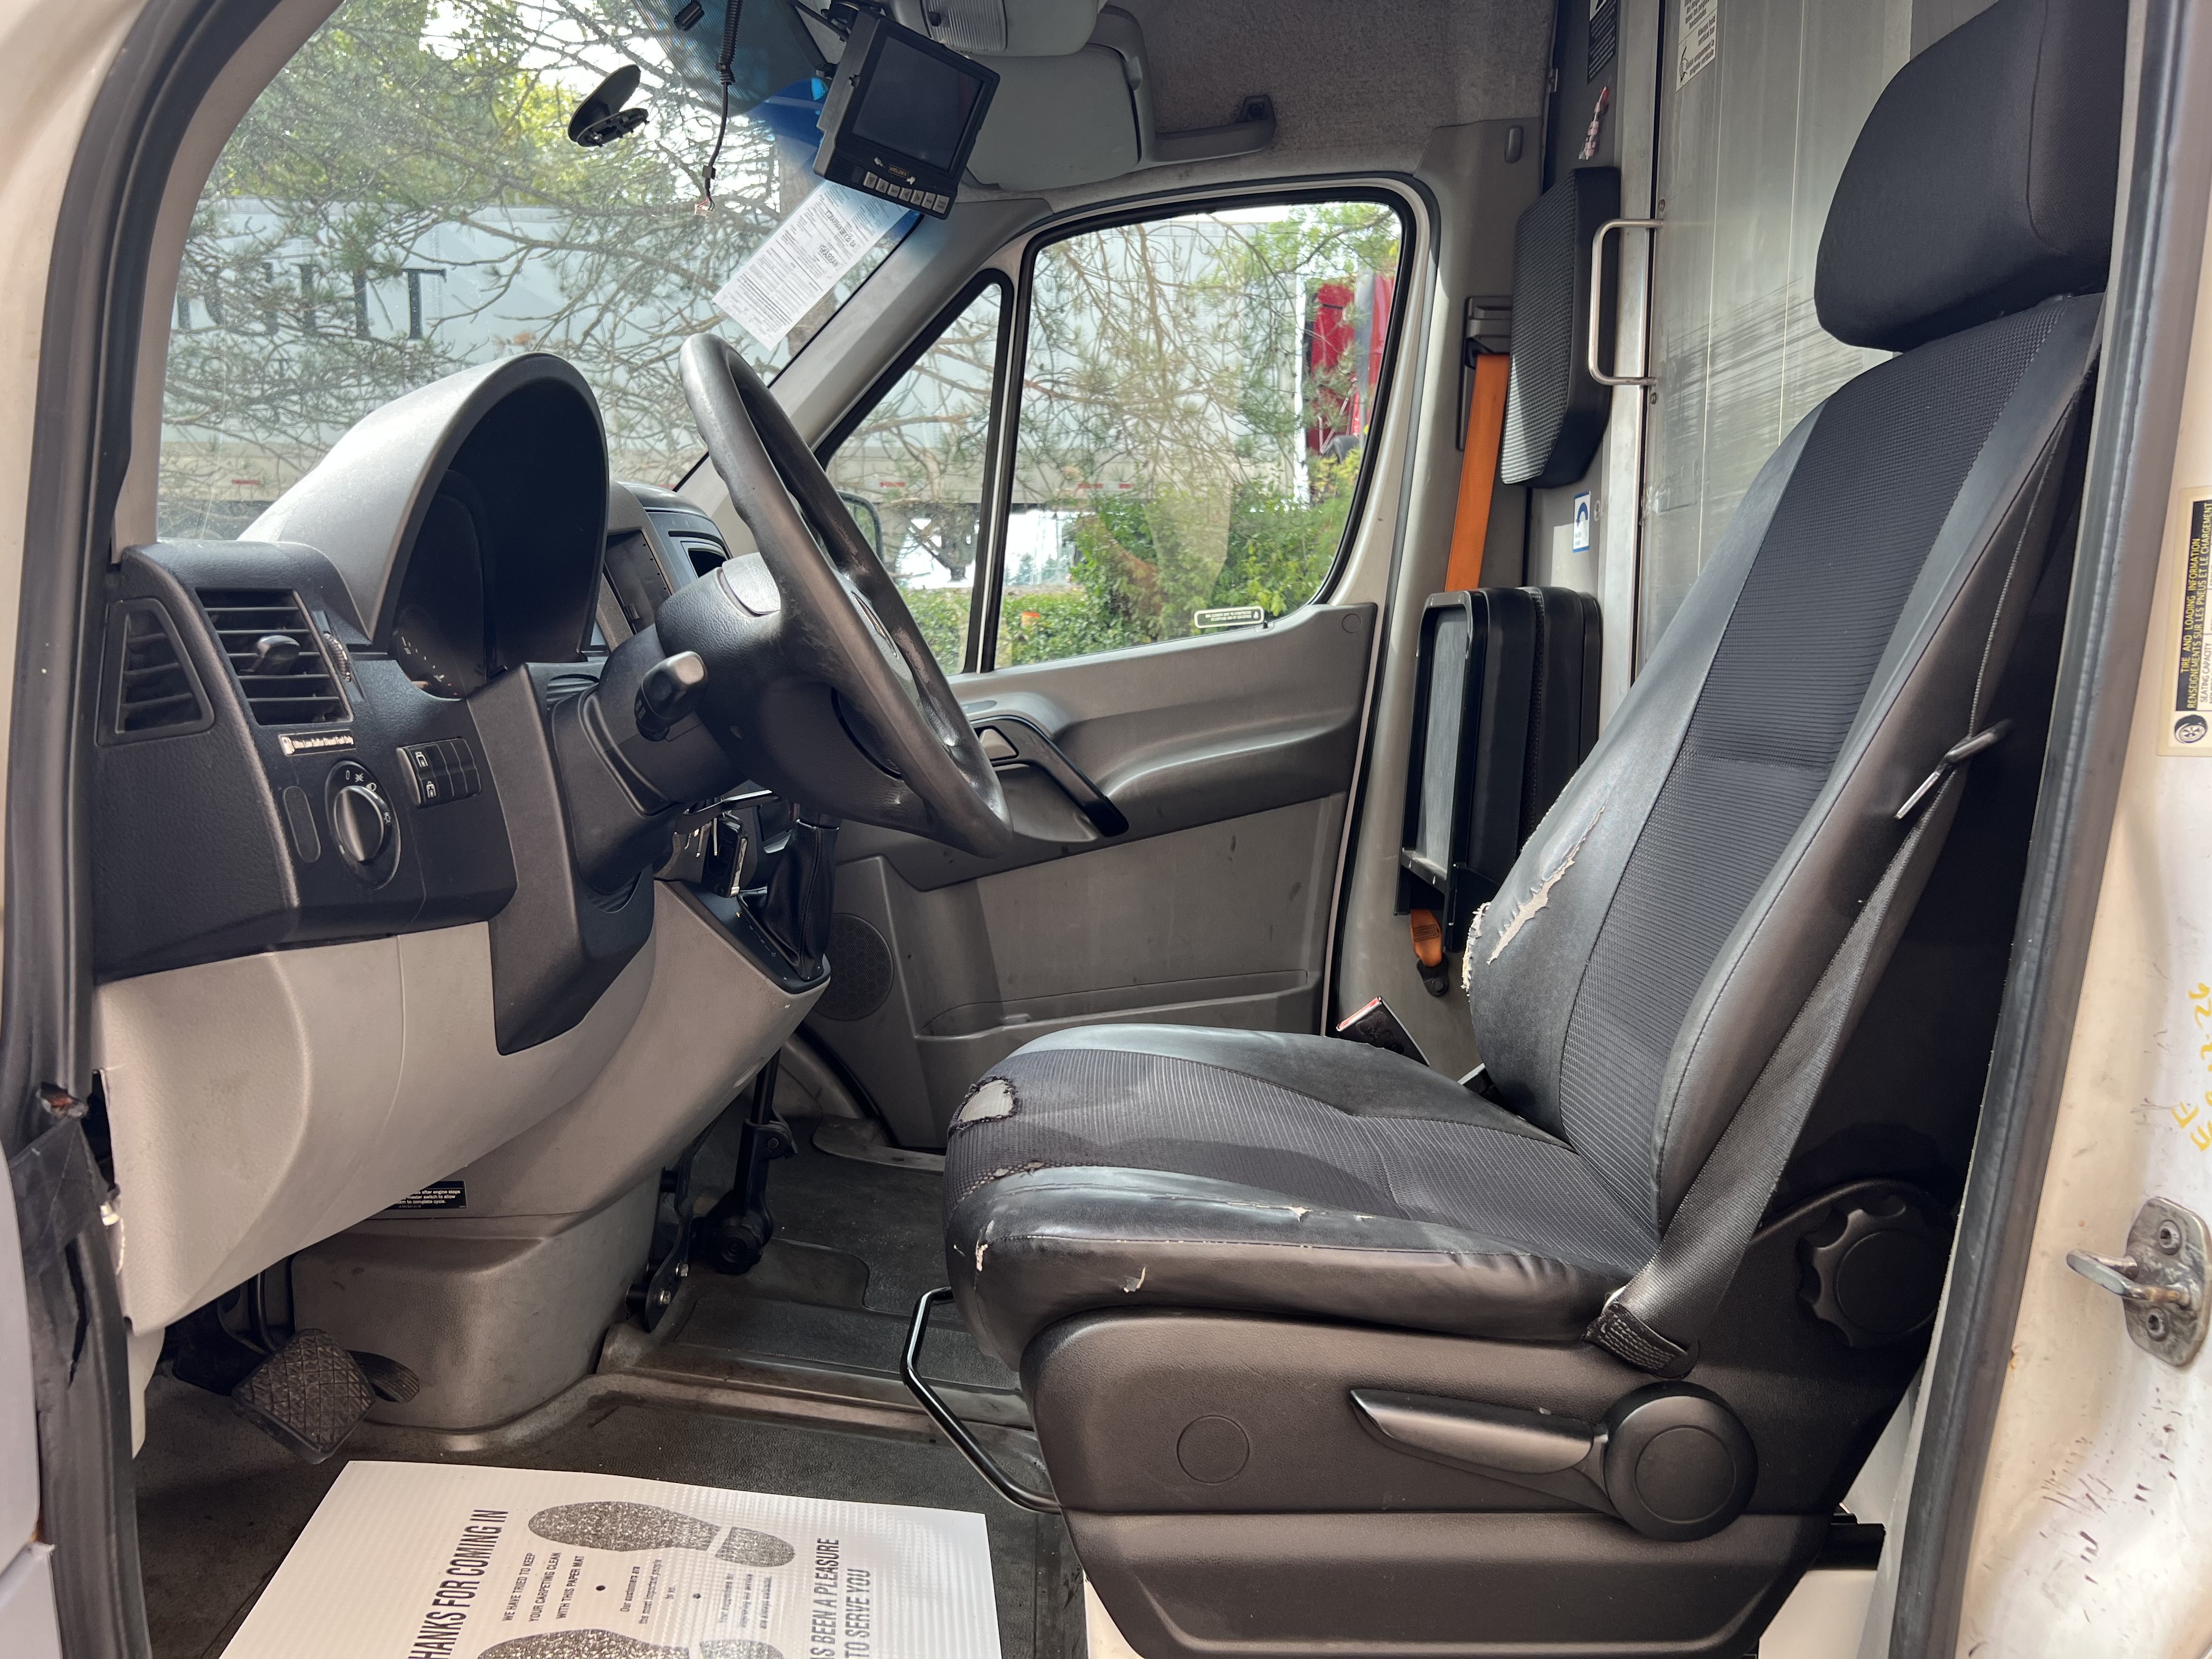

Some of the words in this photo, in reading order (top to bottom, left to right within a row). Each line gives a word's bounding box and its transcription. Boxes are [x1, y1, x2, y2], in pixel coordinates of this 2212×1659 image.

[2200, 503, 2212, 554] CHARGEMENT
[2188, 538, 2200, 591] INFORMATION
[2199, 556, 2209, 565] LE
[2198, 568, 2207, 579] ET
[2196, 580, 2207, 605] PNEUS
[2184, 595, 2196, 630] LOADING
[2195, 607, 2204, 622] LES
[2194, 623, 2203, 640] SUR
[2182, 635, 2193, 651] AND
[2181, 657, 2190, 673] TIRE
[2202, 643, 2212, 673] CAPACITY
[2187, 641, 2202, 709] RENSEIGNEMENTS
[2200, 675, 2208, 703] SEATING
[470, 1509, 509, 1522] IN
[445, 1526, 503, 1576] COMING
[522, 1552, 535, 1566] KEEP
[546, 1552, 561, 1570] CLEAN
[572, 1555, 584, 1567] MAT
[651, 1559, 662, 1575] people
[814, 1538, 839, 1595] PLEASURE
[519, 1567, 531, 1576] TO
[566, 1568, 581, 1587] PAPER
[847, 1568, 871, 1593] YOU
[432, 1580, 480, 1607] FOR
[512, 1576, 528, 1594] TRIED
[535, 1571, 555, 1604] CARPETING
[625, 1576, 638, 1601] customers
[644, 1576, 658, 1600] important
[506, 1594, 521, 1610] HAVE
[562, 1588, 574, 1602] THIS
[813, 1599, 837, 1609] A
[528, 1605, 544, 1622] YOUR
[556, 1602, 570, 1620] WITH
[620, 1602, 631, 1612] Our
[642, 1601, 652, 1614] most
[502, 1611, 515, 1622] WE
[639, 1613, 648, 1624] the
[845, 1596, 870, 1638] SERVE
[811, 1610, 837, 1645] BEEN
[844, 1641, 870, 1659] TO
